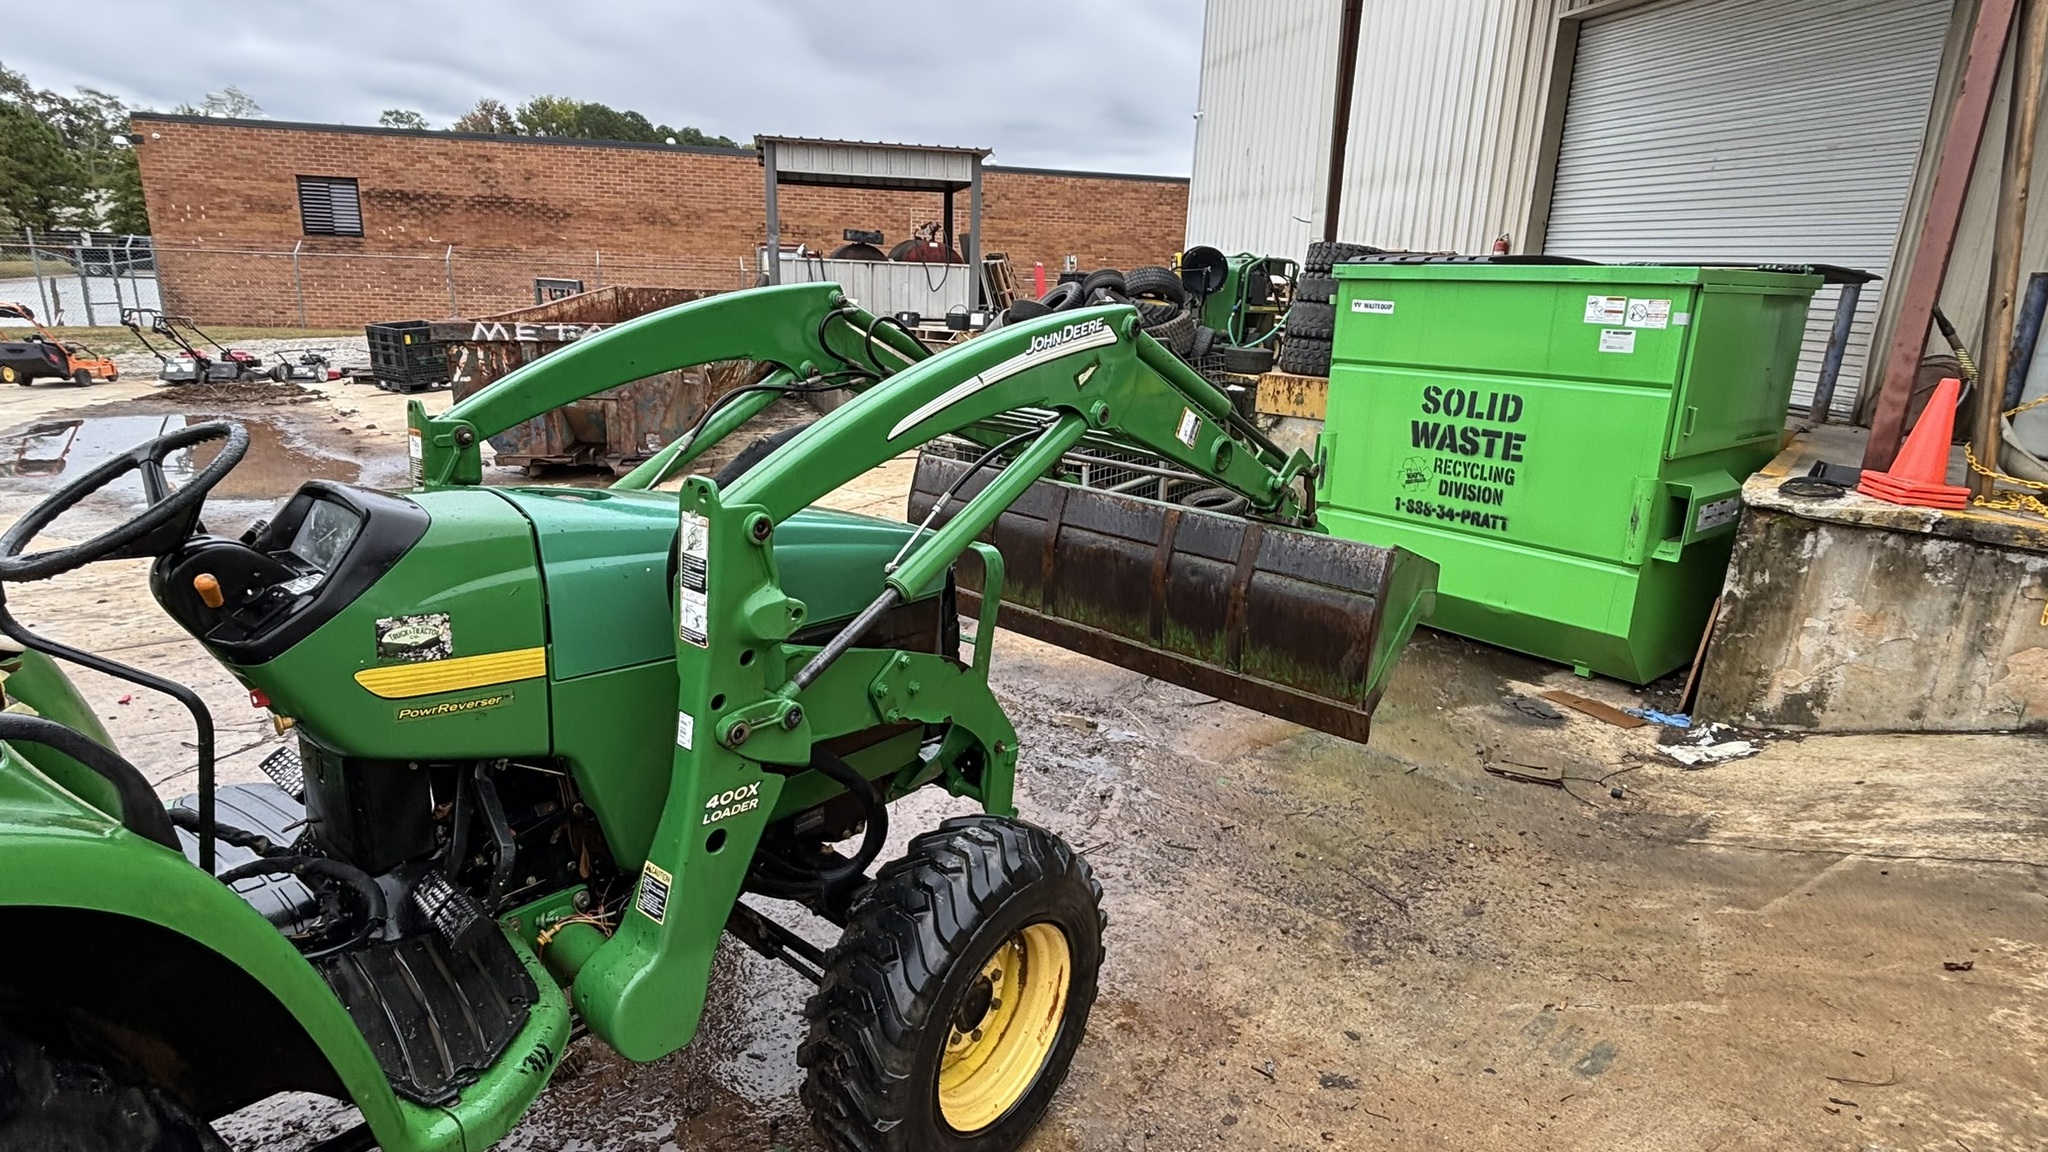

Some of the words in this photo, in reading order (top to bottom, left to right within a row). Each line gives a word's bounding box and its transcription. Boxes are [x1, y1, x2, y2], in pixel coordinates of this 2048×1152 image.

[1026, 331, 1061, 355] JOHN
[1063, 317, 1104, 343] DEERE
[1421, 385, 1524, 423] SOLID
[1411, 420, 1527, 463] WASTE
[1433, 457, 1516, 486] RECYCLING
[1438, 479, 1504, 506] DIVISION
[1395, 497, 1509, 532] 1-888-34-PRATT
[398, 695, 503, 720] PowrReverser
[705, 781, 761, 809] 400X
[702, 797, 759, 826] LOADER
